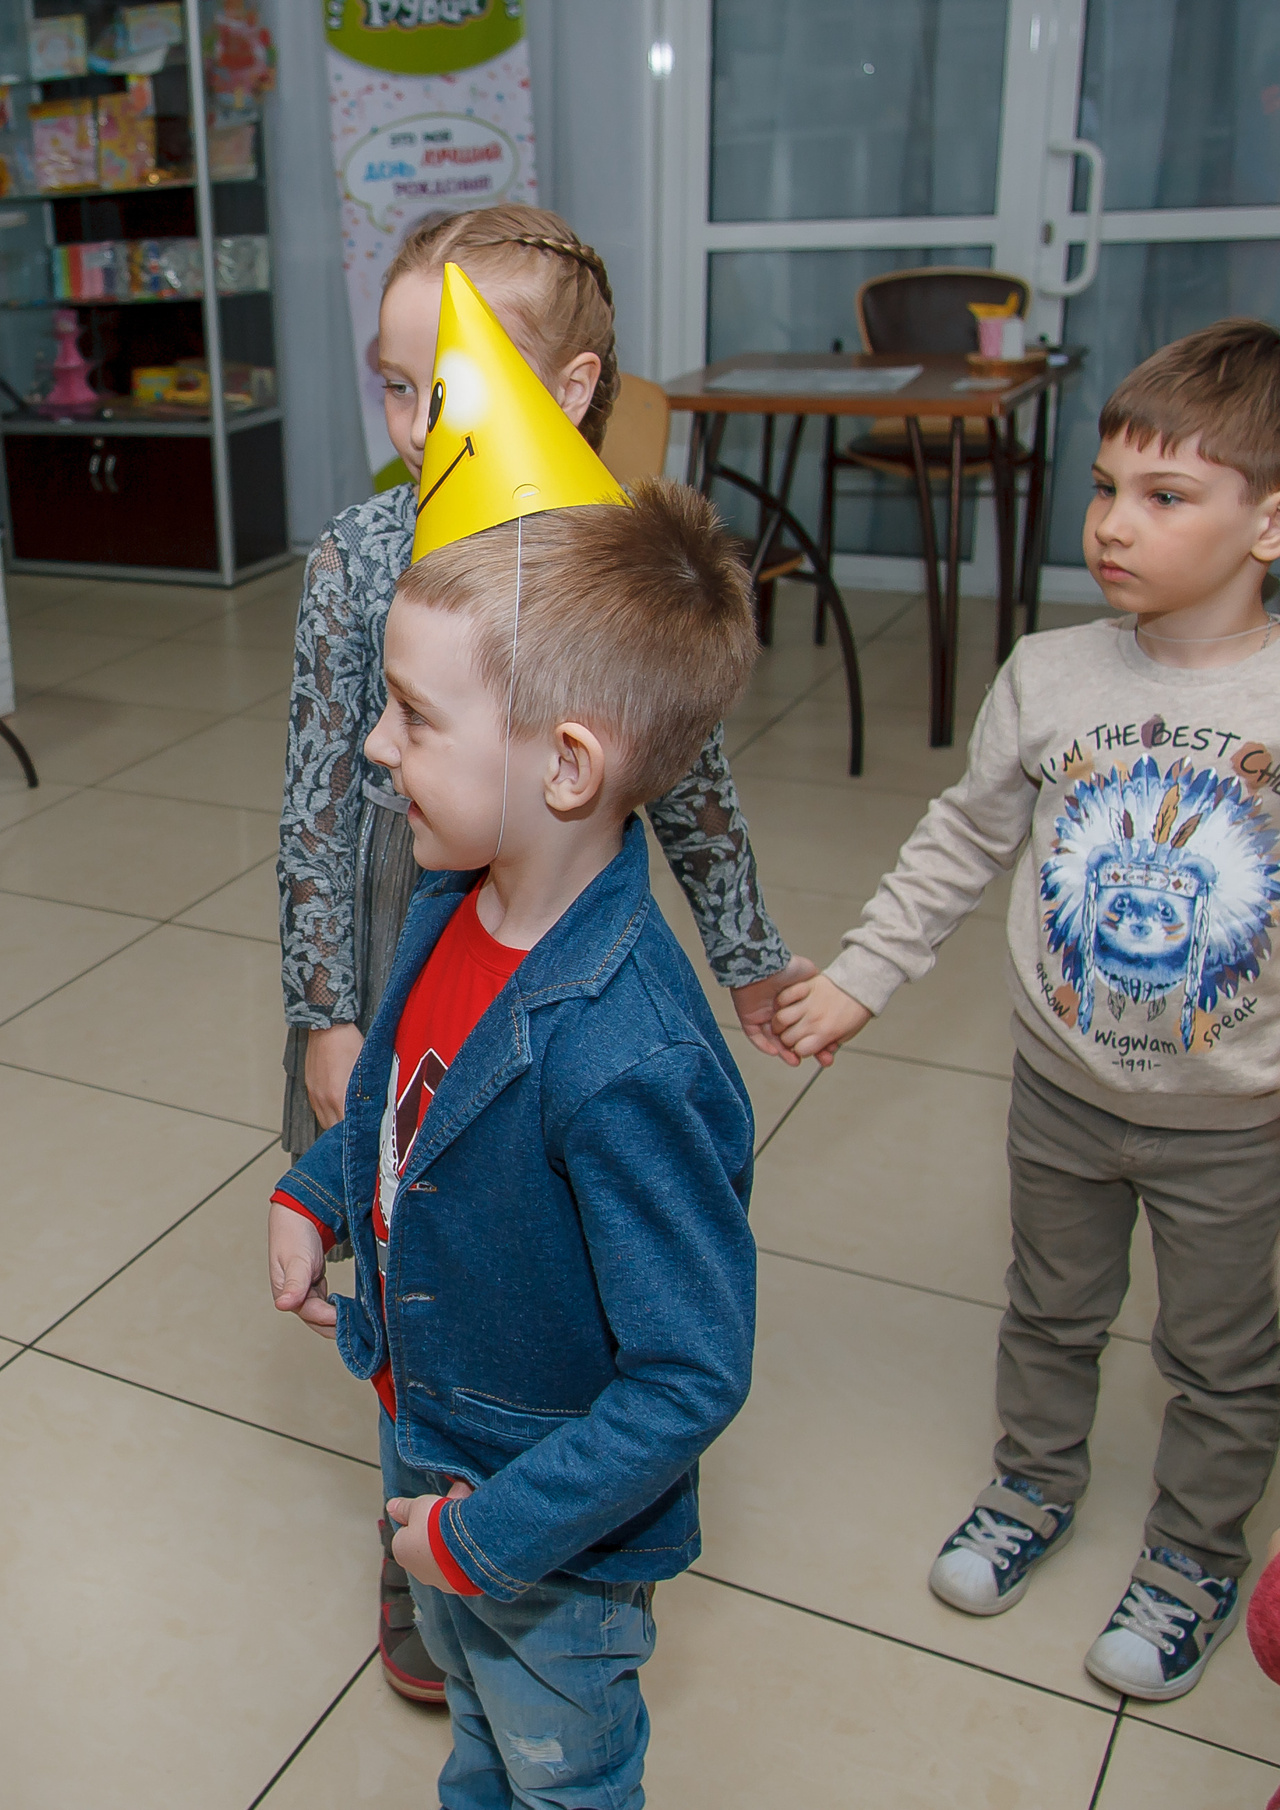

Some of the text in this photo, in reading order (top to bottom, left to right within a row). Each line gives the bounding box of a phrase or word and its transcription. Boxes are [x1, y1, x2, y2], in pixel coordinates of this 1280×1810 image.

[1040, 739, 1083, 784] I'M
[1086, 723, 1139, 750] THE
[1151, 722, 1241, 758] BEST
